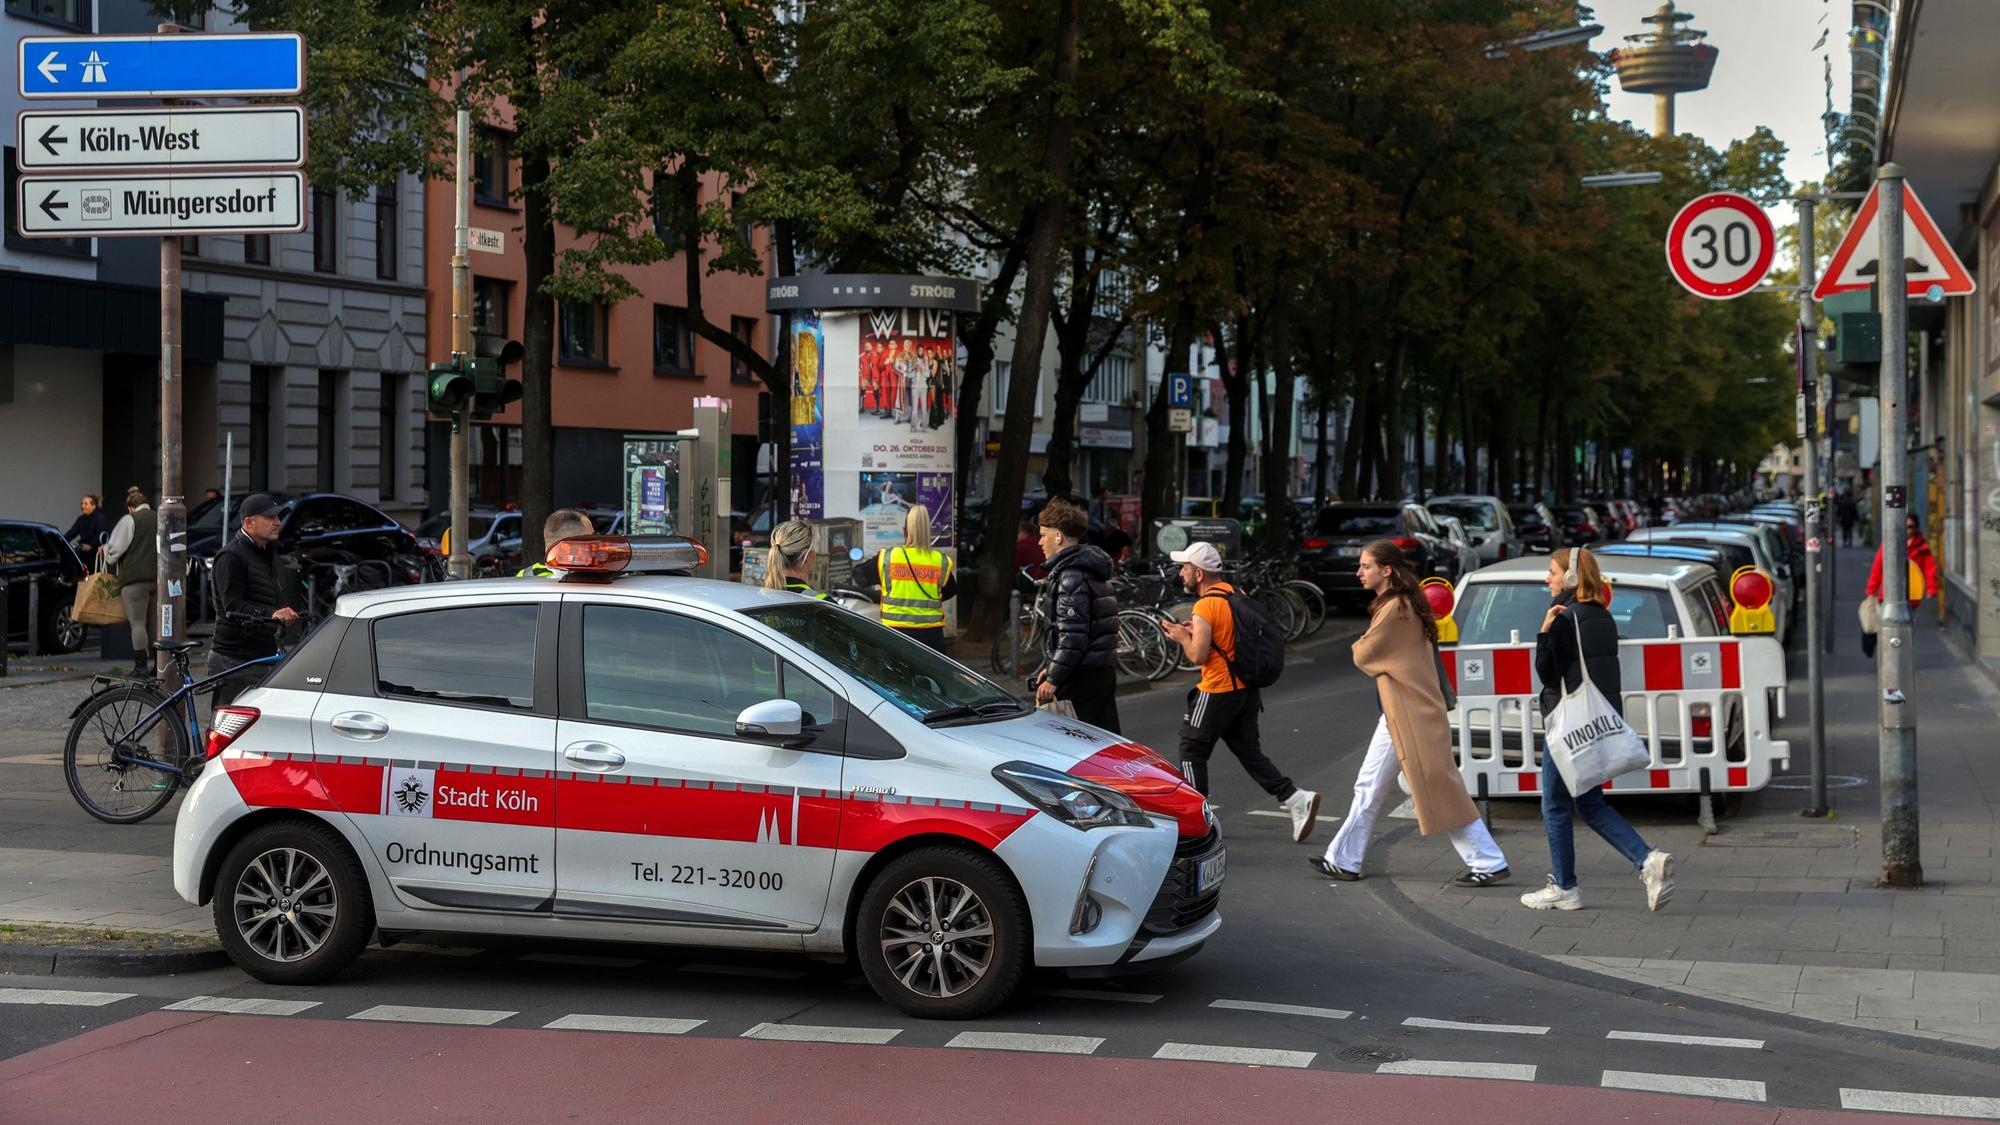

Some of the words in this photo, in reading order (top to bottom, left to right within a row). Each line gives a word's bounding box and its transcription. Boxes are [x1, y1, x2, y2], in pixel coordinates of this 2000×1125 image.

[80, 126, 200, 152] Köln-West
[123, 187, 276, 220] Müngersdorf
[1691, 221, 1751, 269] 30
[770, 285, 799, 299] STRÖER
[910, 284, 956, 299] STRÖER
[902, 308, 950, 338] LIVE
[1175, 378, 1187, 403] P
[903, 445, 935, 453] OKTOBER
[1563, 714, 1624, 750] VINOKILO
[437, 785, 490, 808] Stadt
[495, 789, 539, 812] Köln
[851, 785, 889, 794] HYBRID
[386, 842, 540, 875] Ordnungsamt
[631, 862, 664, 882] Tel.
